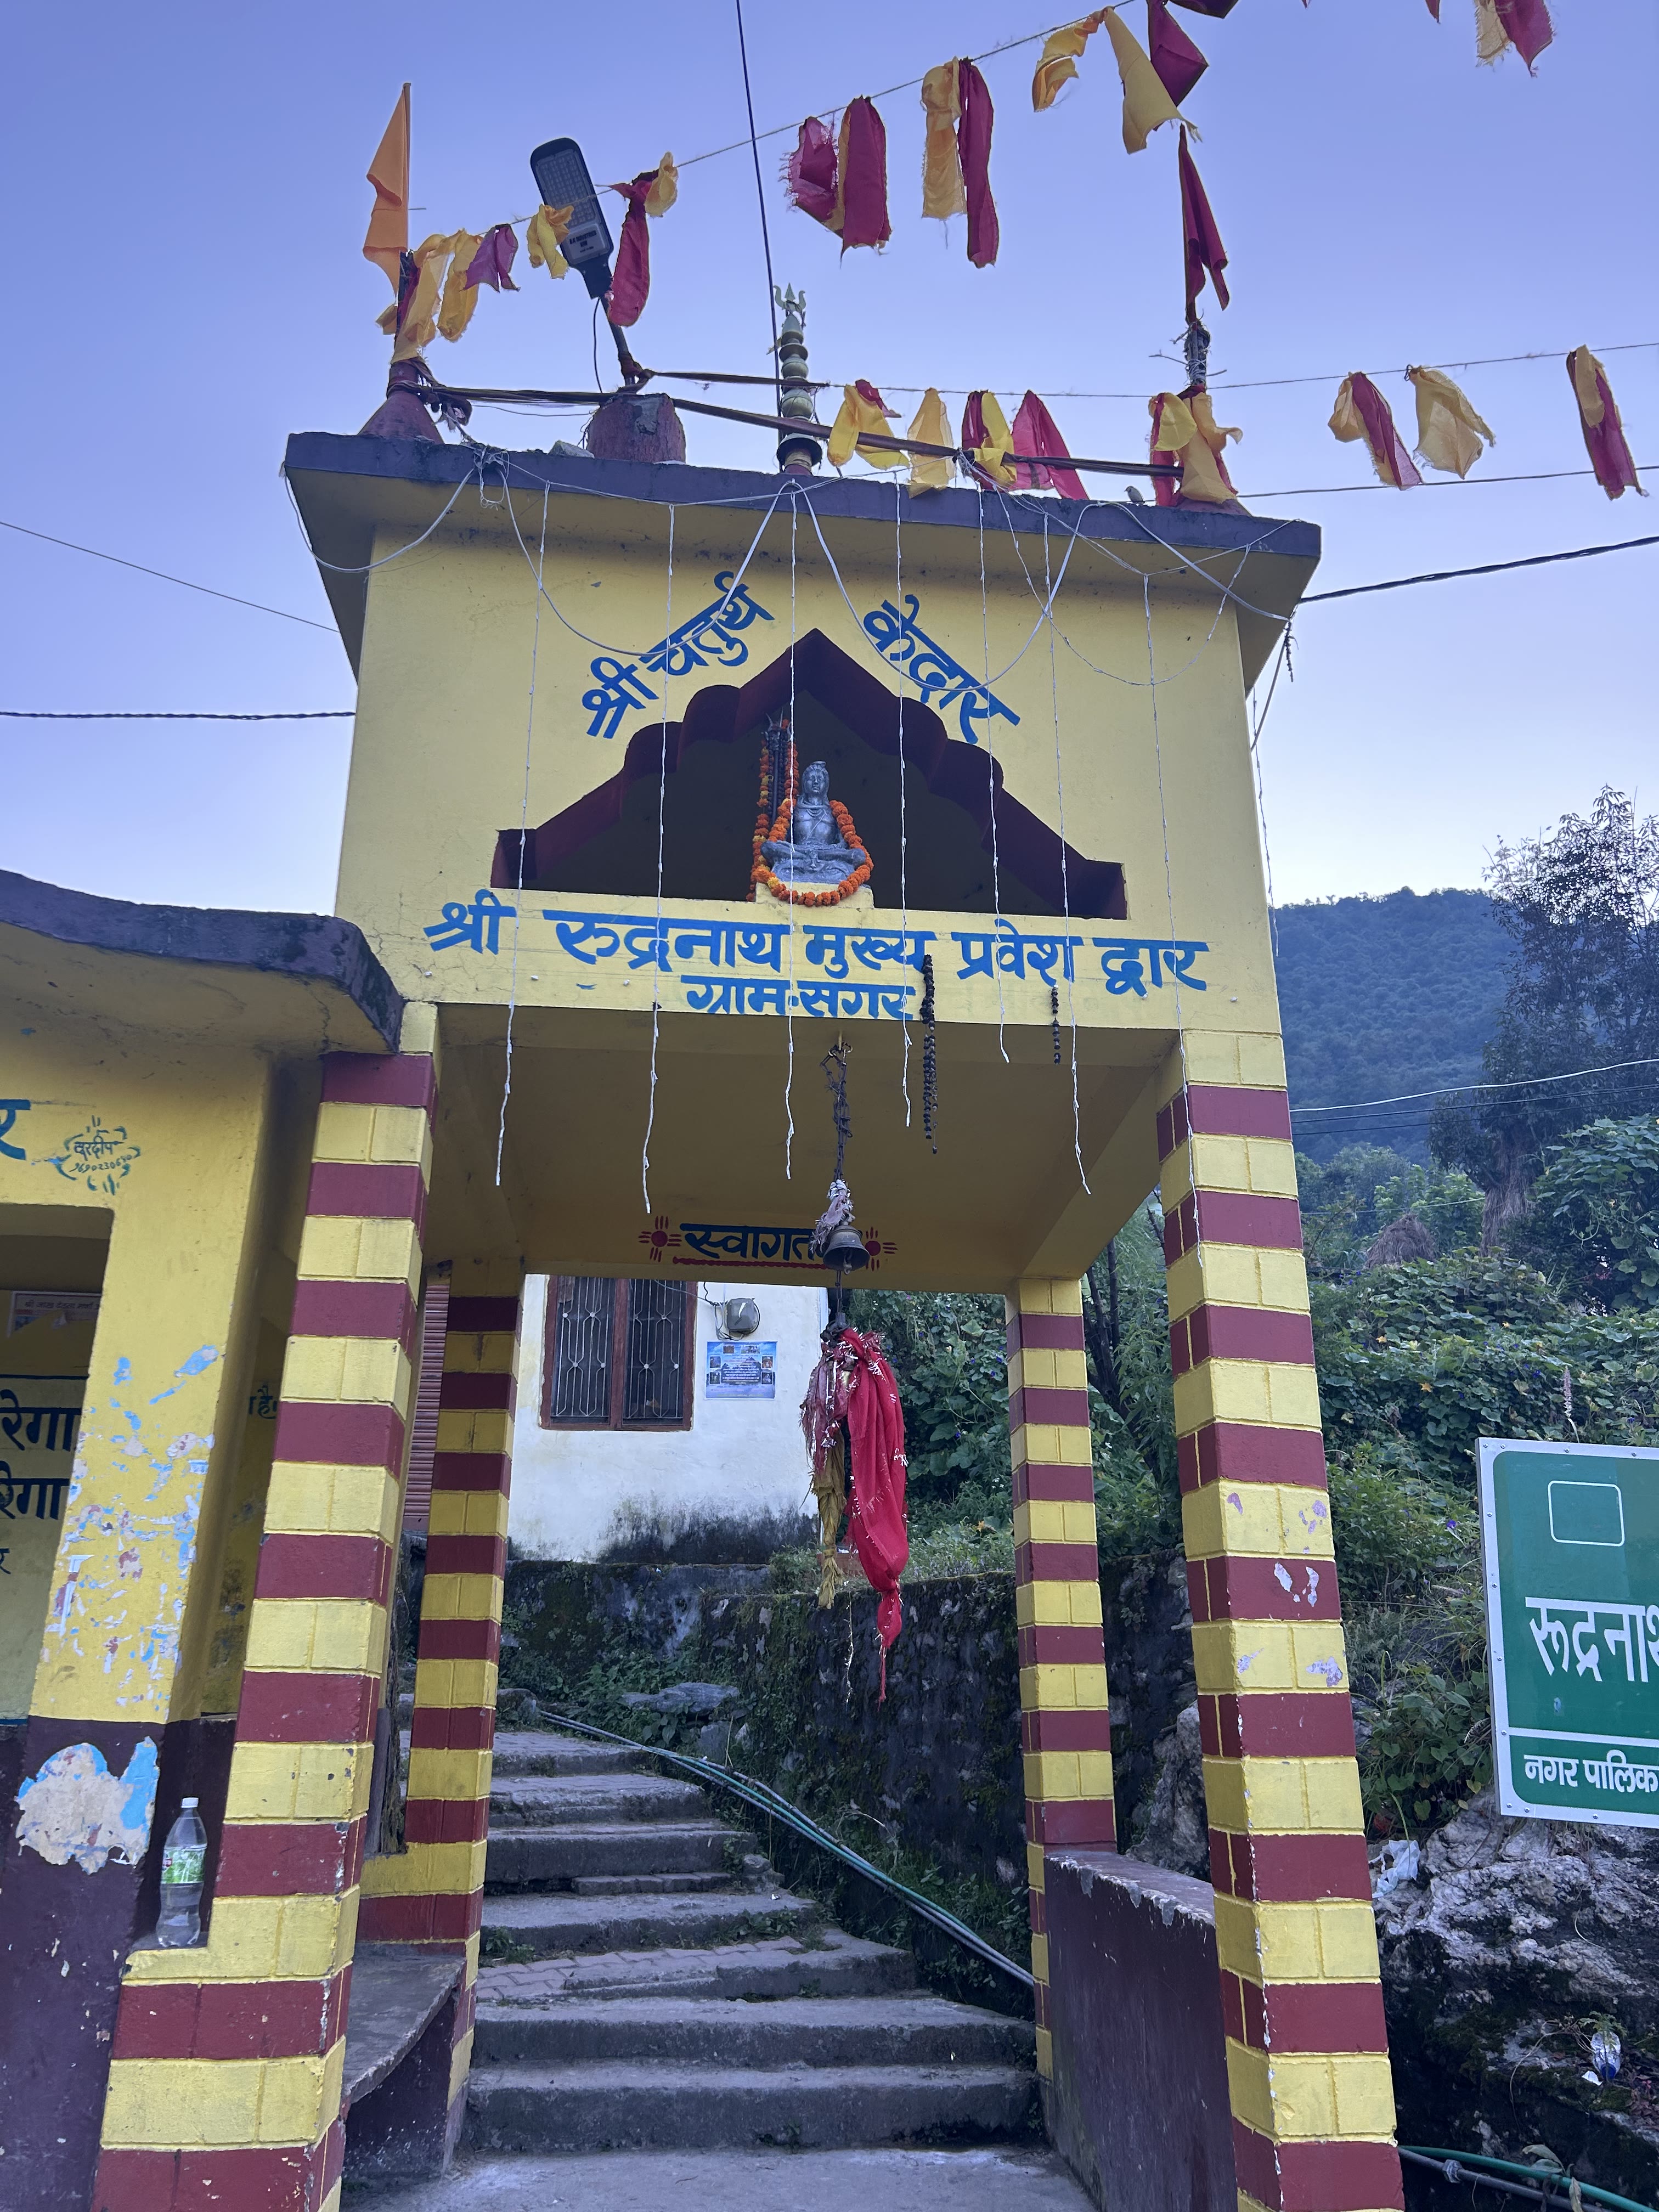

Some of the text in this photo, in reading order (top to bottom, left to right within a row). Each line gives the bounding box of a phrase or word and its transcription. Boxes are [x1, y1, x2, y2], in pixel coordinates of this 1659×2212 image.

[582, 571, 1021, 745] श्री चतुर्थ केदार
[423, 889, 516, 955] श्री
[803, 924, 938, 979] मुख्य
[951, 918, 1084, 985] प्रवेश
[1092, 937, 1209, 995] द्वार
[680, 1223, 863, 1262] स्वागत
[1523, 1754, 1579, 1787] नगर
